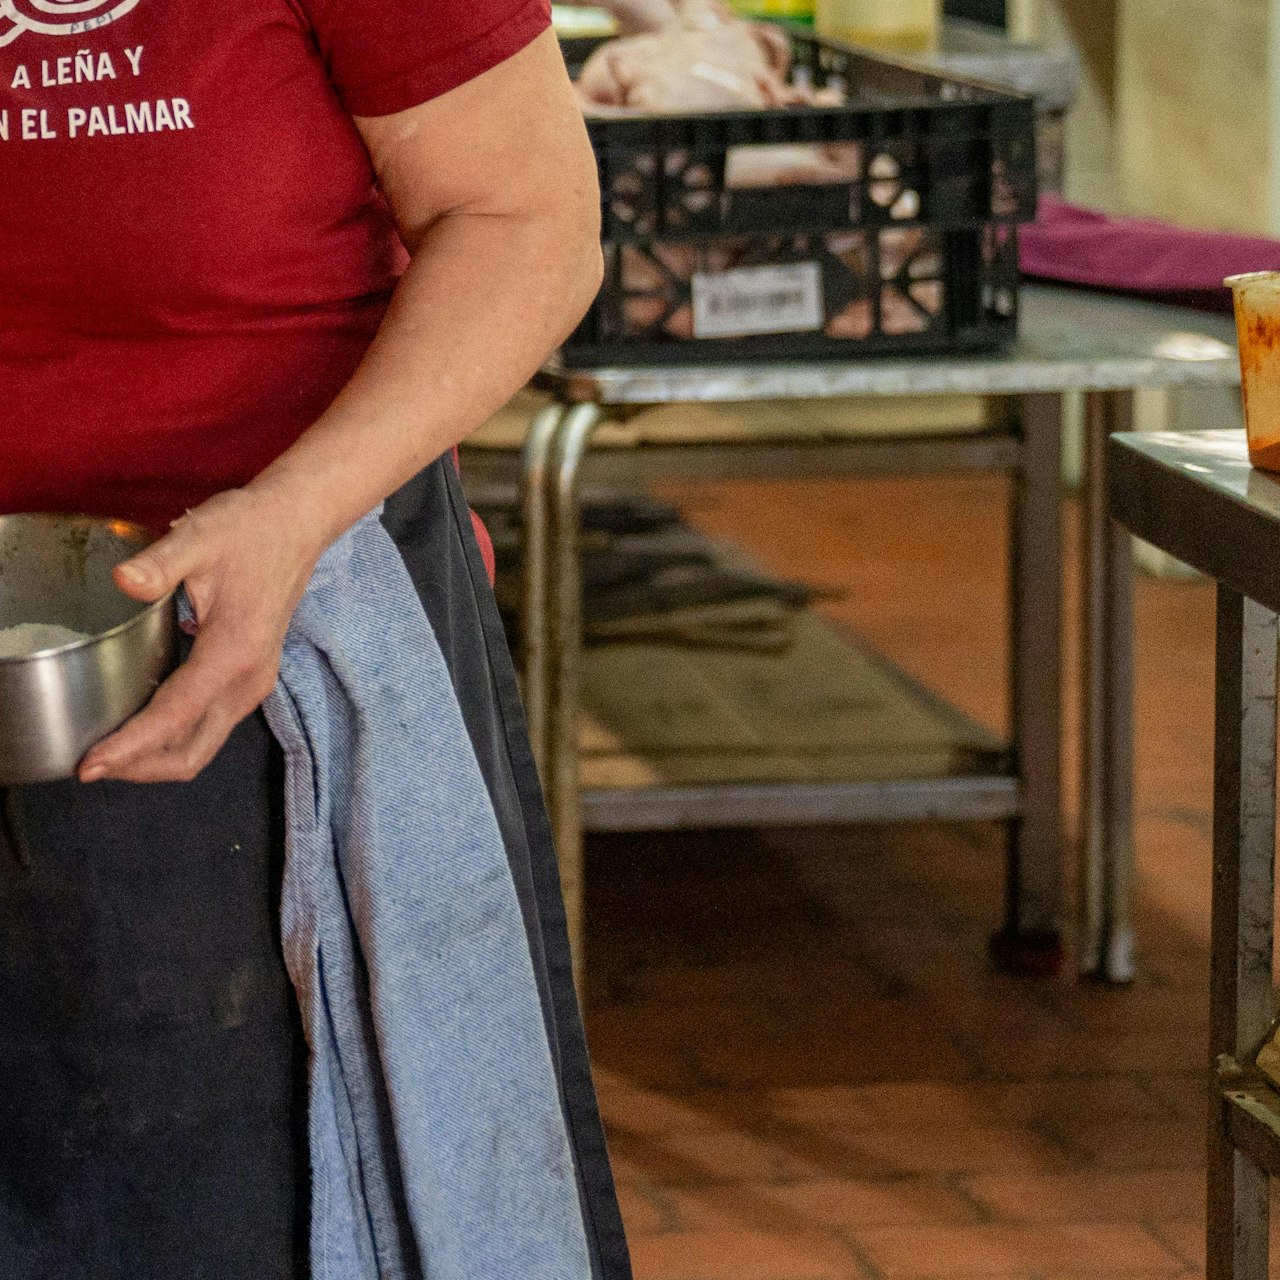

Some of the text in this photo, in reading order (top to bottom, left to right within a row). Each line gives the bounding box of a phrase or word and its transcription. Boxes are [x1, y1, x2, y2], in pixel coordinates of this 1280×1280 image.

[10, 45, 145, 90] A LEÑA Y
[21, 108, 57, 141] EL
[68, 97, 195, 139] PALMAR
